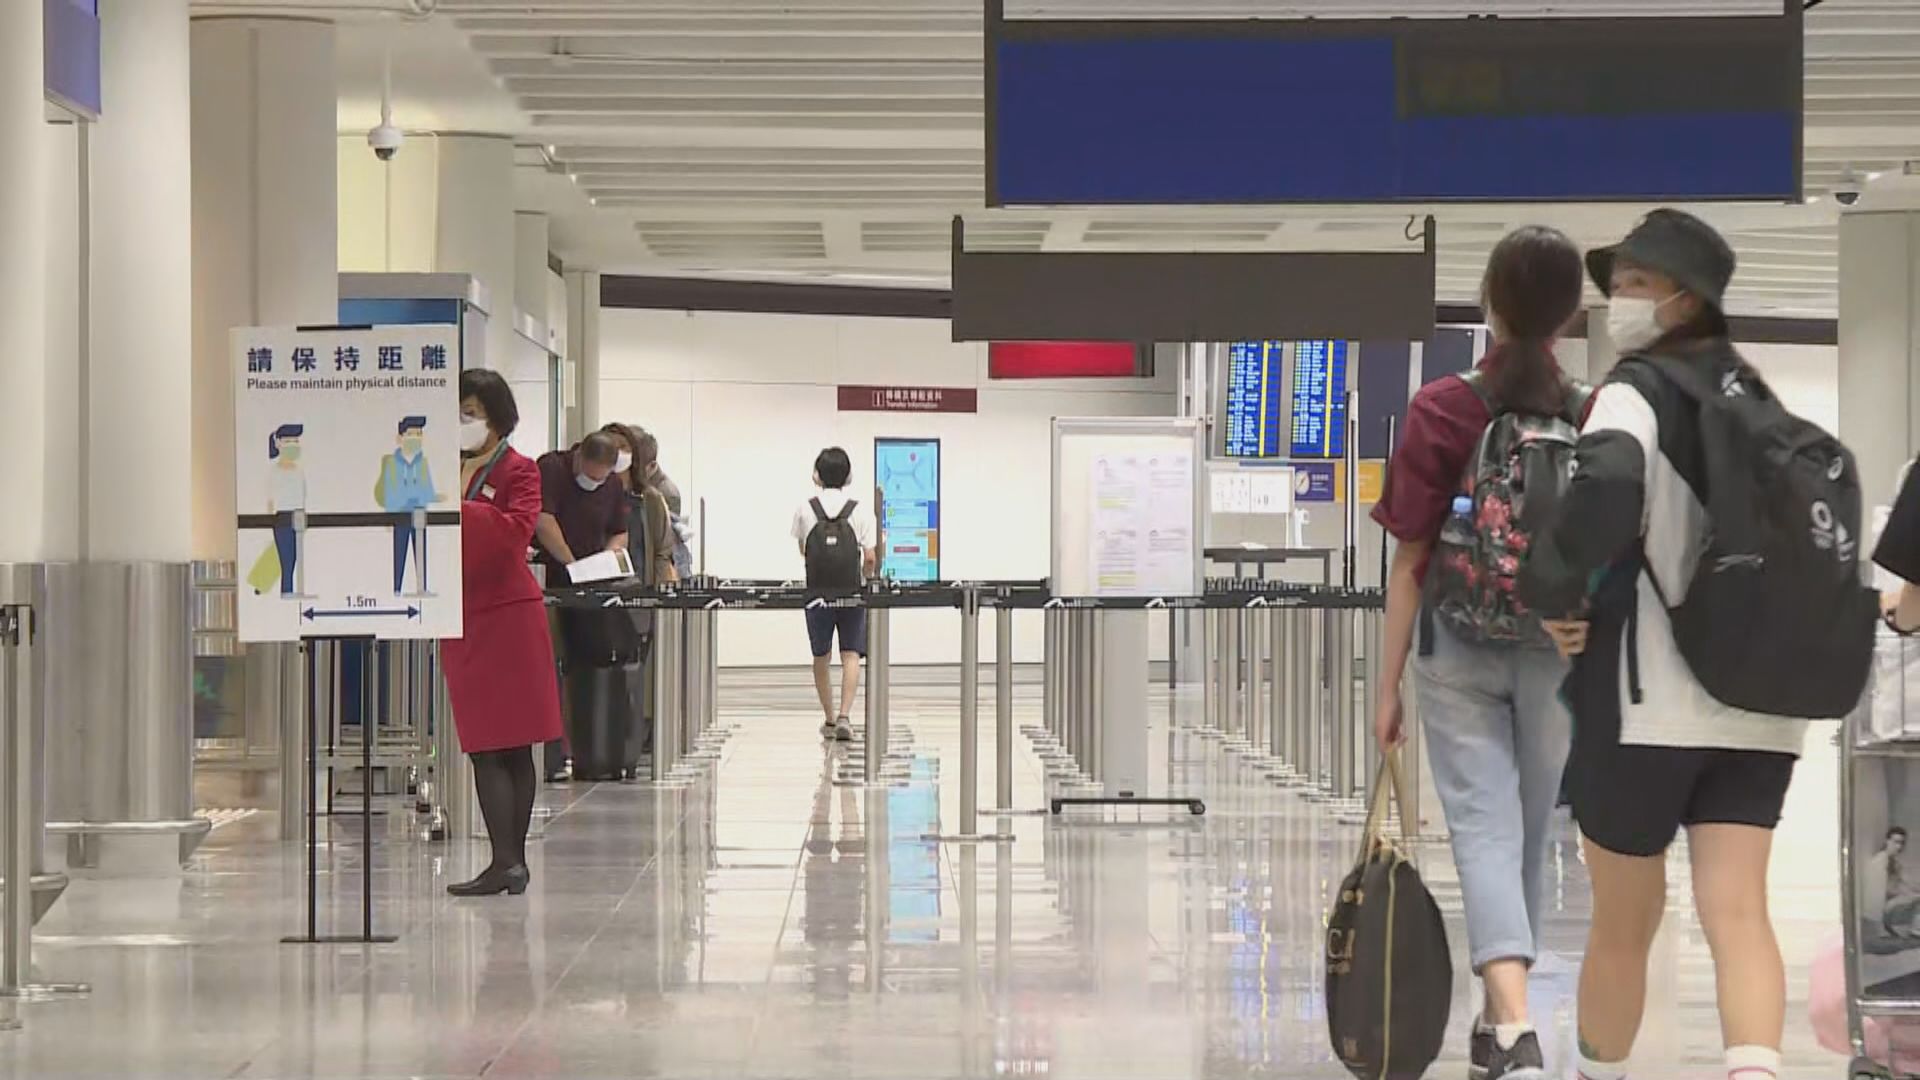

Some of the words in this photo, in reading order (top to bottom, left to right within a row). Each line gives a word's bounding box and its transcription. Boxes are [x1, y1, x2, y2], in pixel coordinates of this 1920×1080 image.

[247, 345, 447, 373] 請保持距離
[247, 378, 287, 389] Please
[290, 378, 343, 389] maintain
[345, 377, 394, 391] physical
[397, 376, 447, 388] distance
[346, 596, 377, 607] 1.5m
